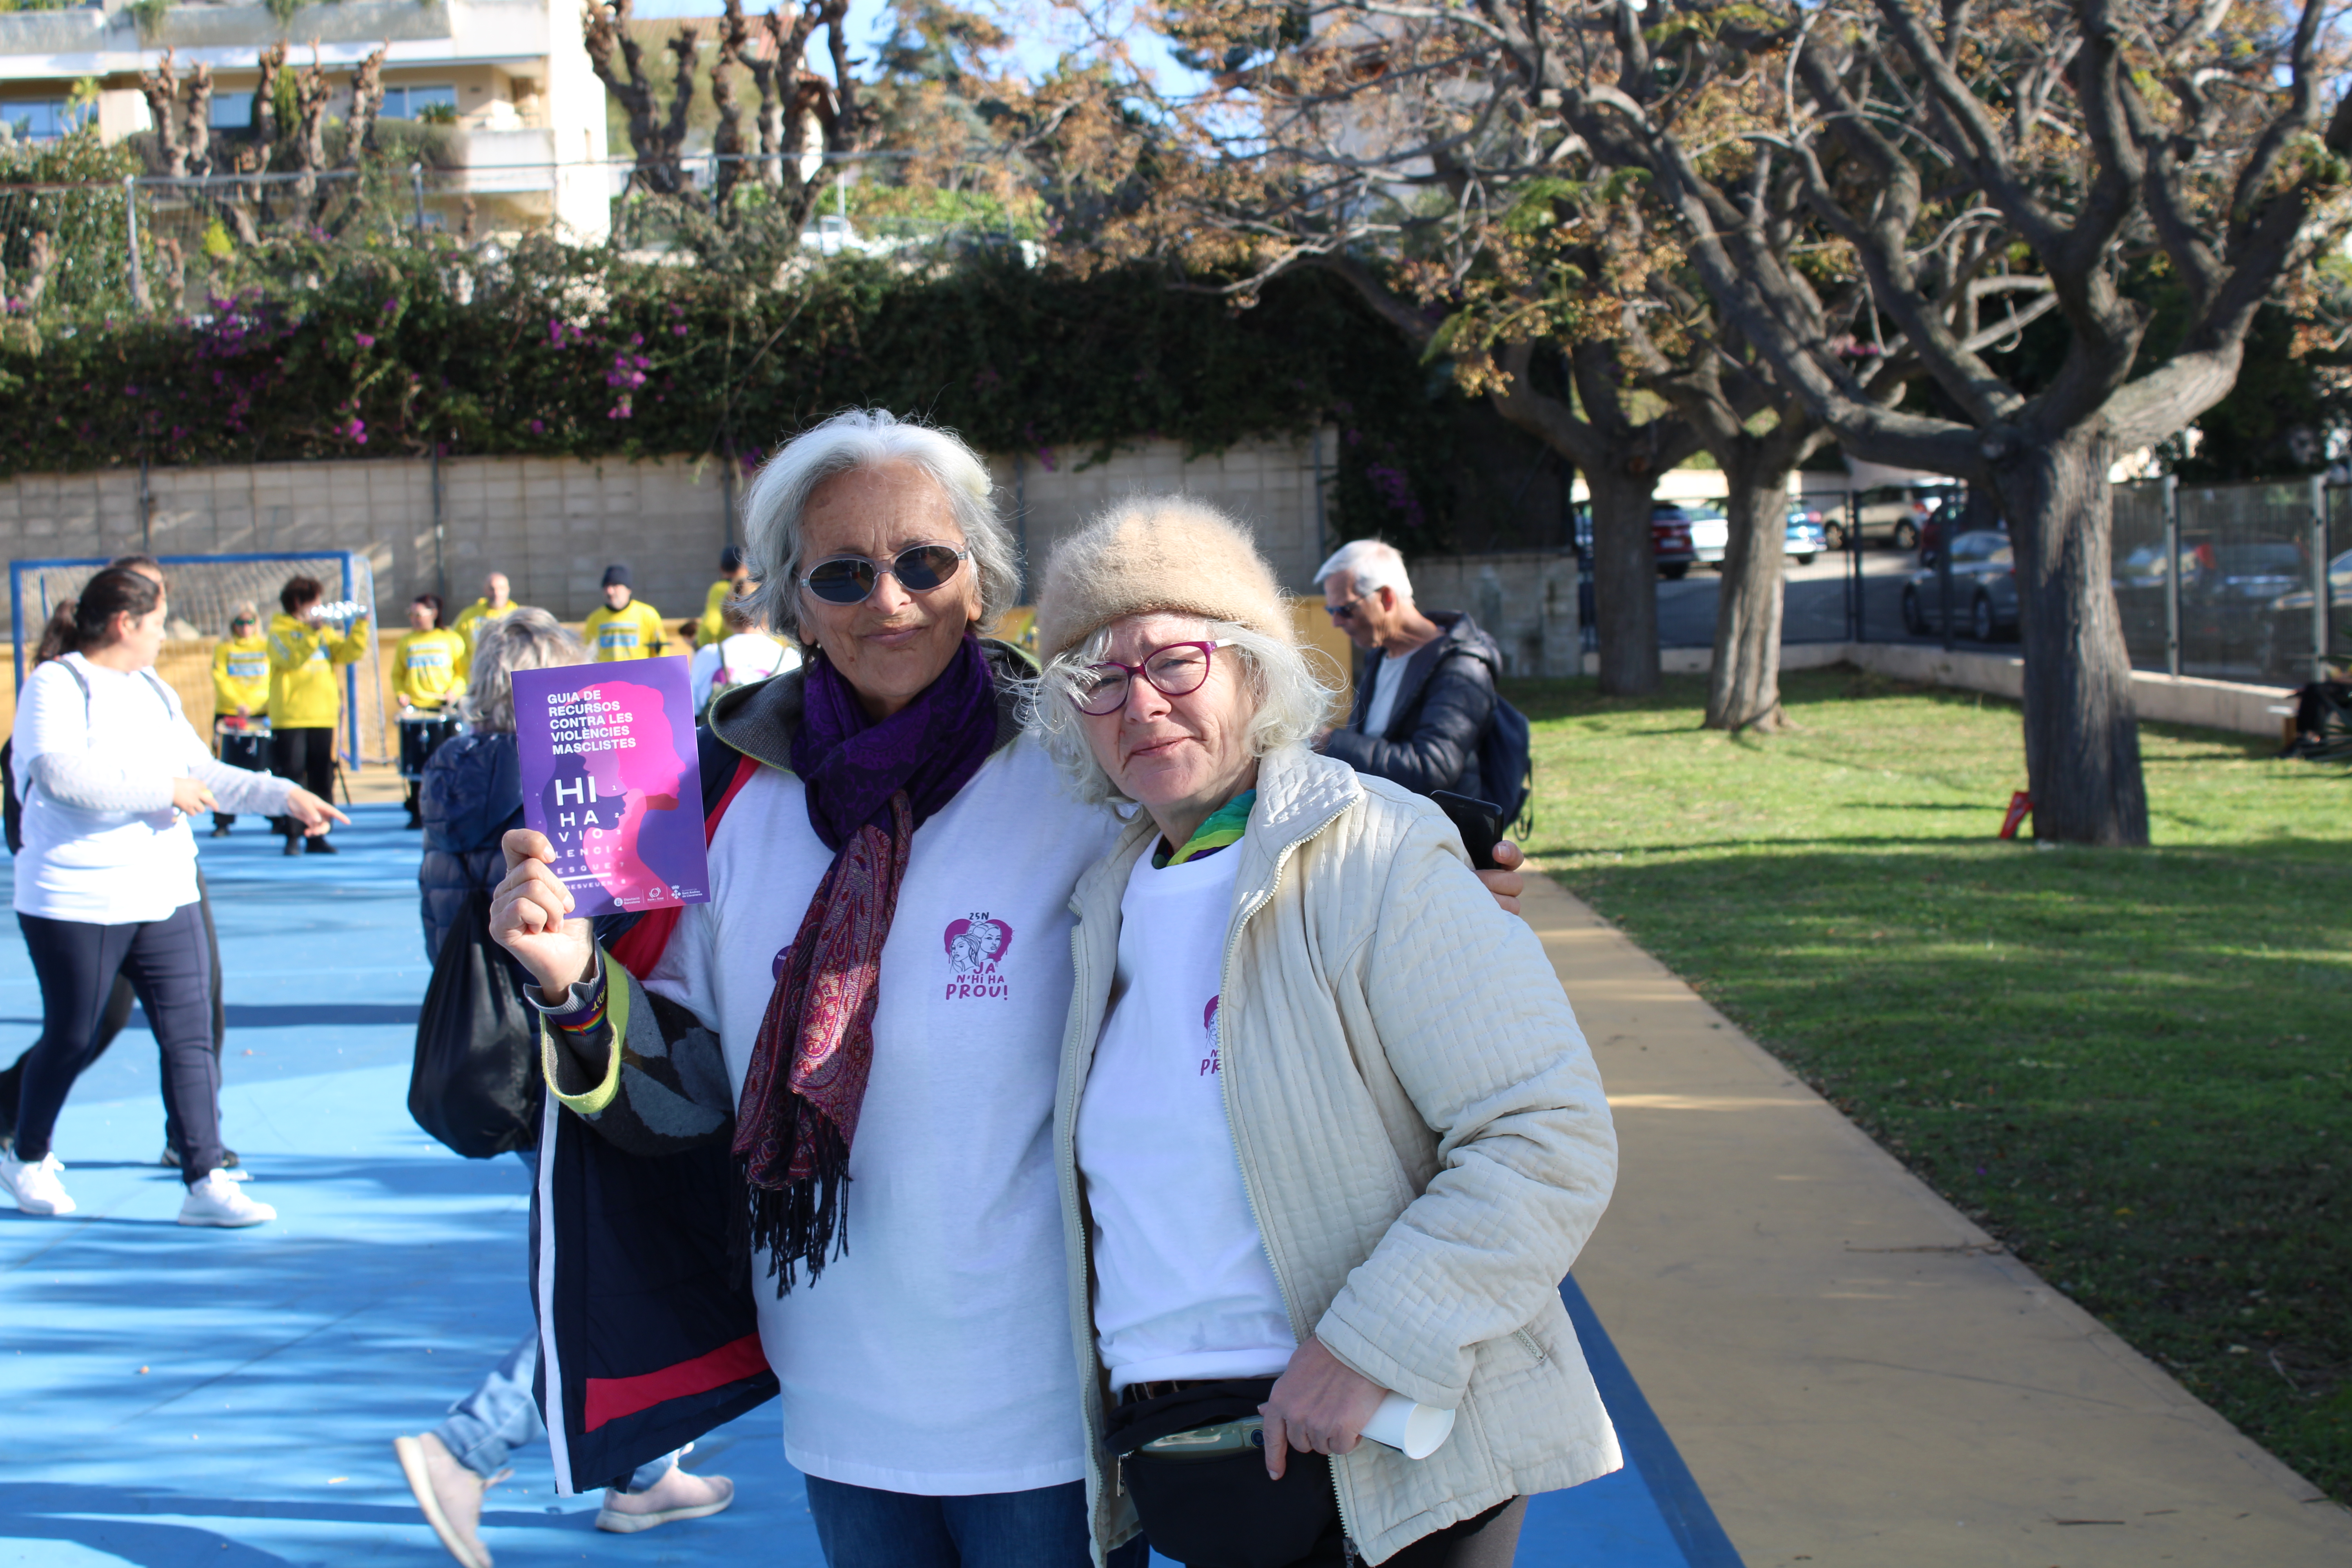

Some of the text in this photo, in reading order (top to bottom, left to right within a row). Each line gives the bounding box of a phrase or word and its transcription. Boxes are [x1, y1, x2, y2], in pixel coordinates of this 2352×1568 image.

[547, 690, 601, 704] GUIA DE
[548, 701, 621, 717] RECURSOS
[550, 712, 633, 730] CONTRA LES
[551, 725, 630, 742] VIOLÈNCIES
[552, 737, 637, 755] MASCLISTES
[555, 776, 597, 806] HI
[969, 912, 989, 920] 25N
[973, 962, 995, 974] JA
[988, 975, 1004, 984] HA
[946, 984, 1008, 1000] PROU!
